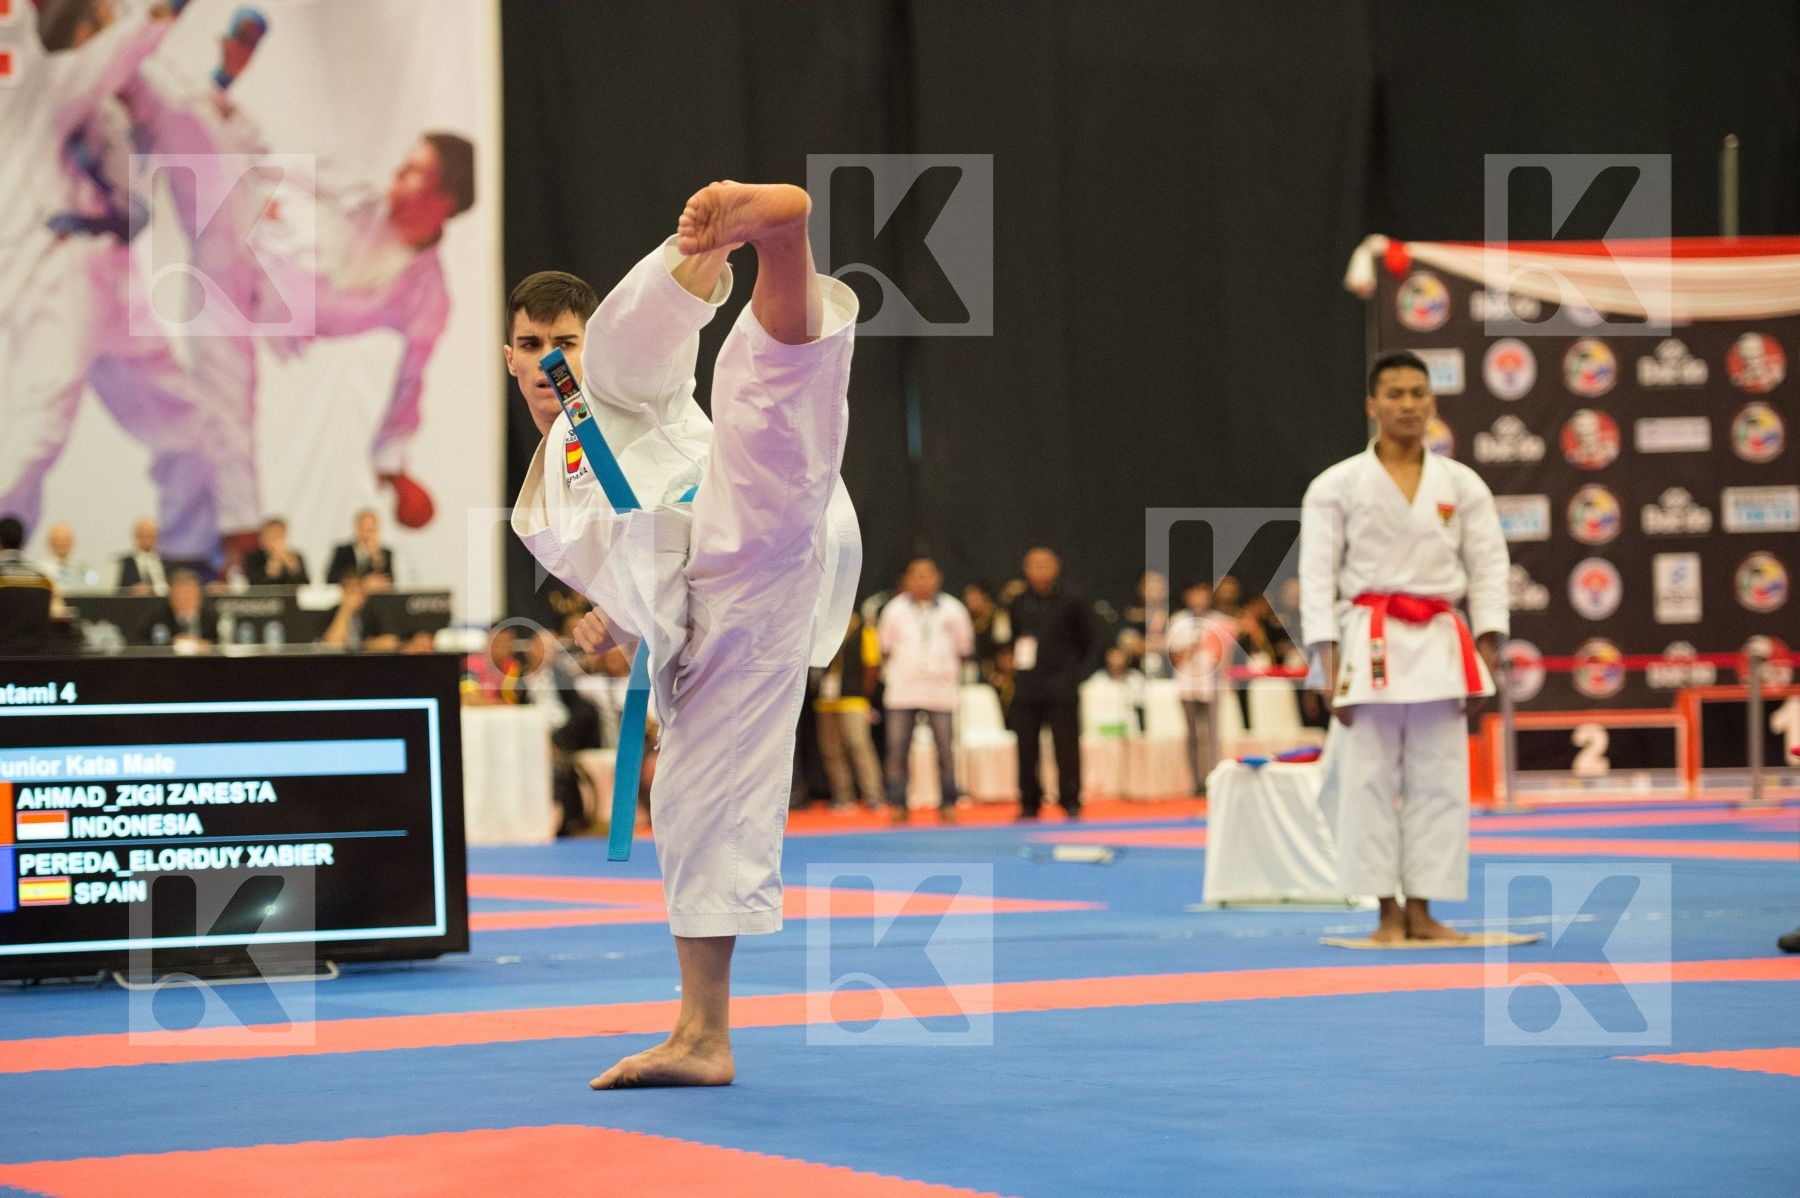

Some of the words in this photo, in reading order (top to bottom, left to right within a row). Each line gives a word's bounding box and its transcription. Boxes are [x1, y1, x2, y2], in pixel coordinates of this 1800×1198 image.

[0, 682, 57, 704] atami
[60, 682, 78, 704] 4
[1571, 723, 1610, 777] 2
[0, 755, 62, 777] unior
[65, 754, 118, 776] Kata
[122, 753, 176, 775] Male
[16, 783, 165, 812] AHMAD_ZIGI
[166, 780, 278, 805] ZARESTA
[72, 813, 204, 838] INDONESIA
[19, 846, 244, 877] PEREDA_ELORDUY
[246, 843, 334, 868] XABIER
[74, 880, 147, 905] SPAIN
